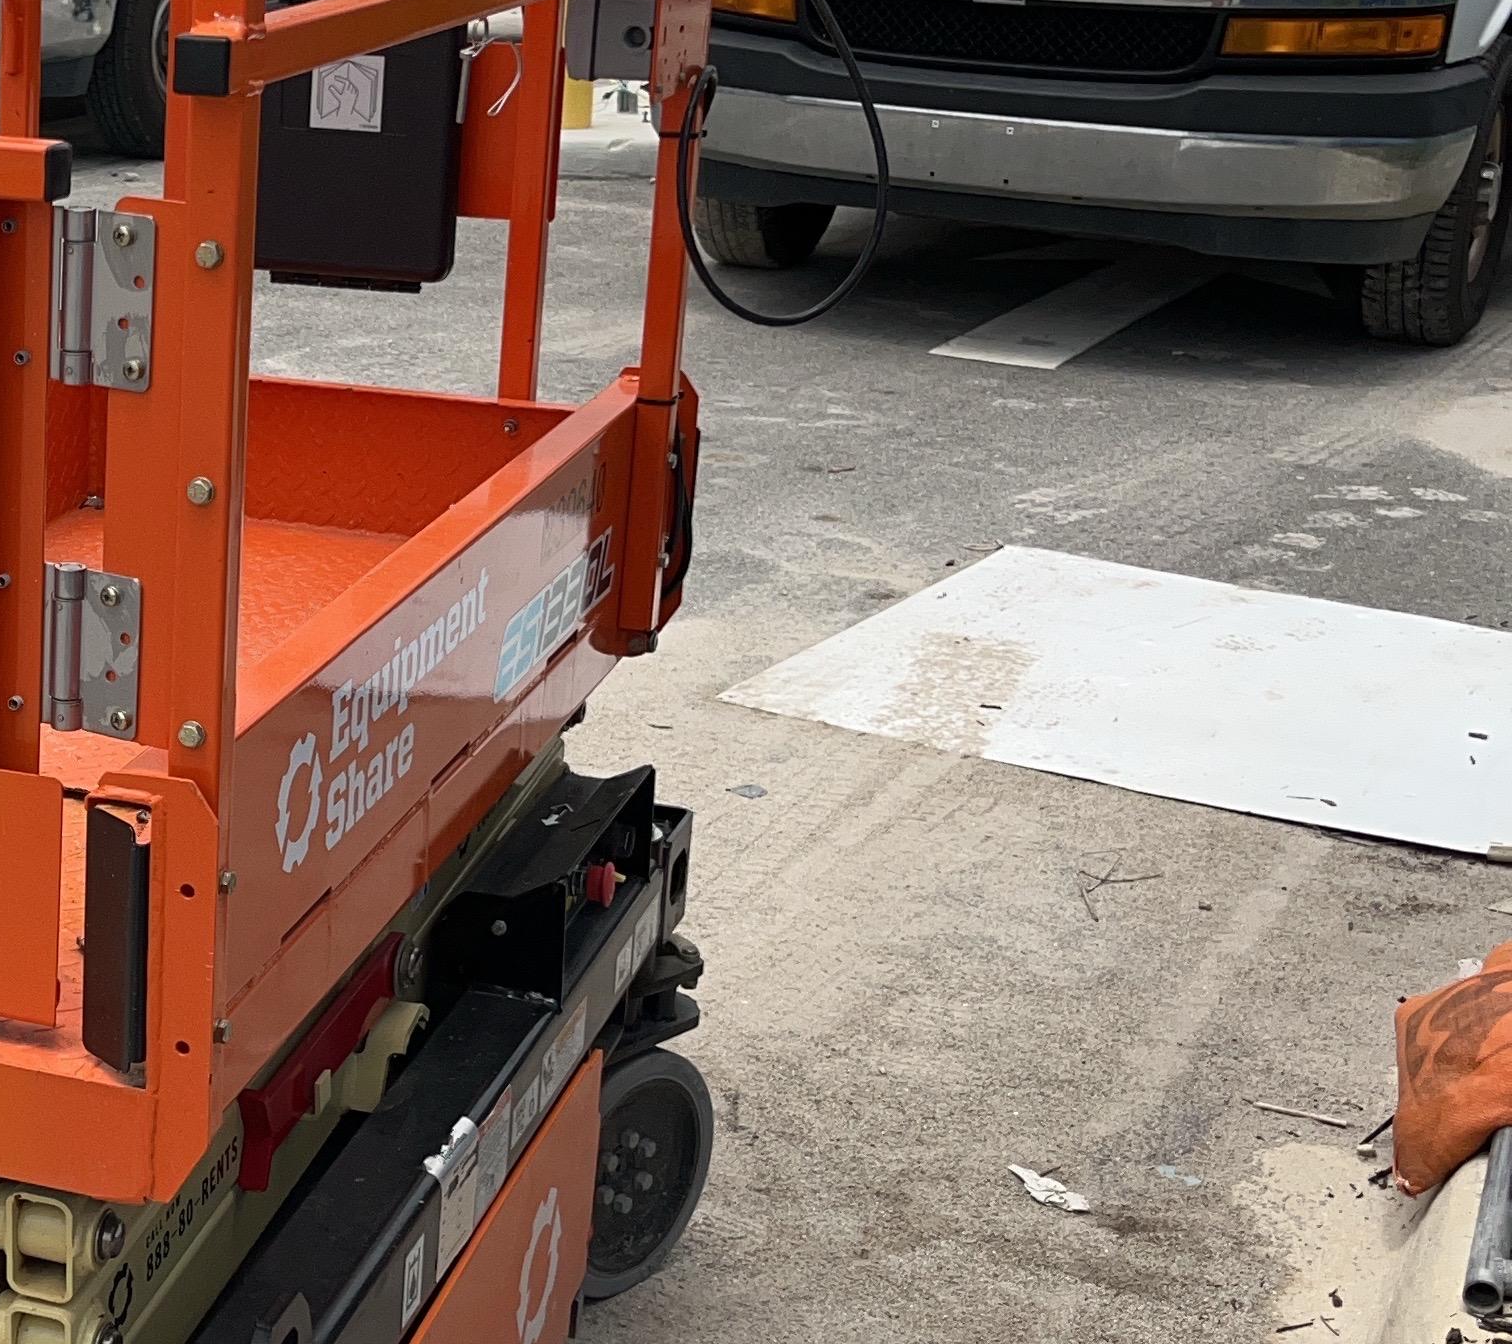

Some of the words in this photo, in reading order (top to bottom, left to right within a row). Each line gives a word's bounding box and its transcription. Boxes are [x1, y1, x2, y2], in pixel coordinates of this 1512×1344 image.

[329, 568, 488, 764] Equipment
[325, 723, 414, 851] Share
[146, 1136, 238, 1282] 888-80-RENTS
